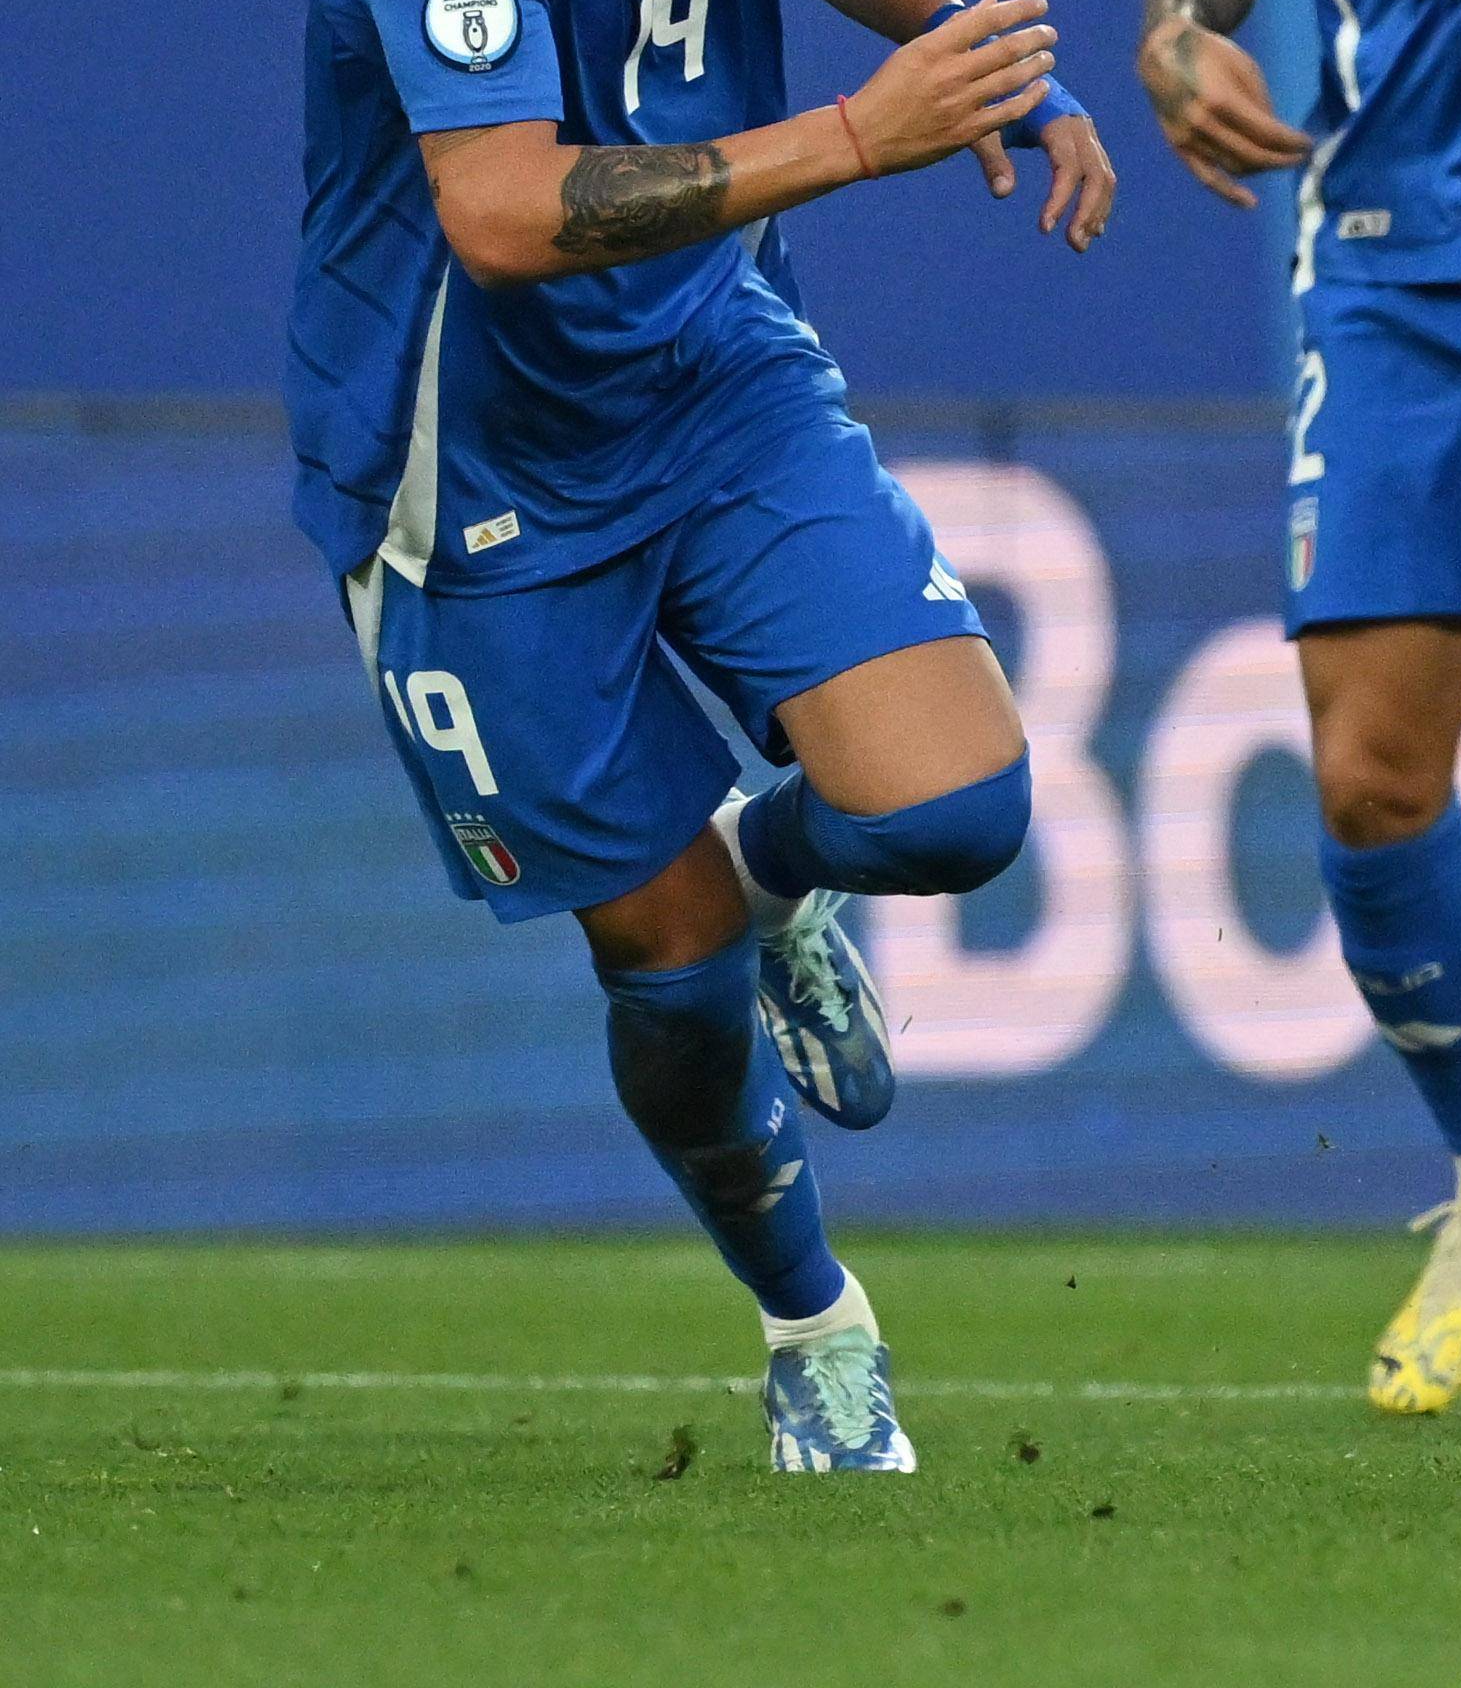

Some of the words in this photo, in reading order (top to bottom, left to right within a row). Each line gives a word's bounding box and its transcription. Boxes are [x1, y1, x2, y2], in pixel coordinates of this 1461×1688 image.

[444, 0, 498, 12] CHAMPIONS
[469, 63, 492, 72] 2020
[1288, 350, 1327, 485] 2
[385, 670, 499, 796] 19
